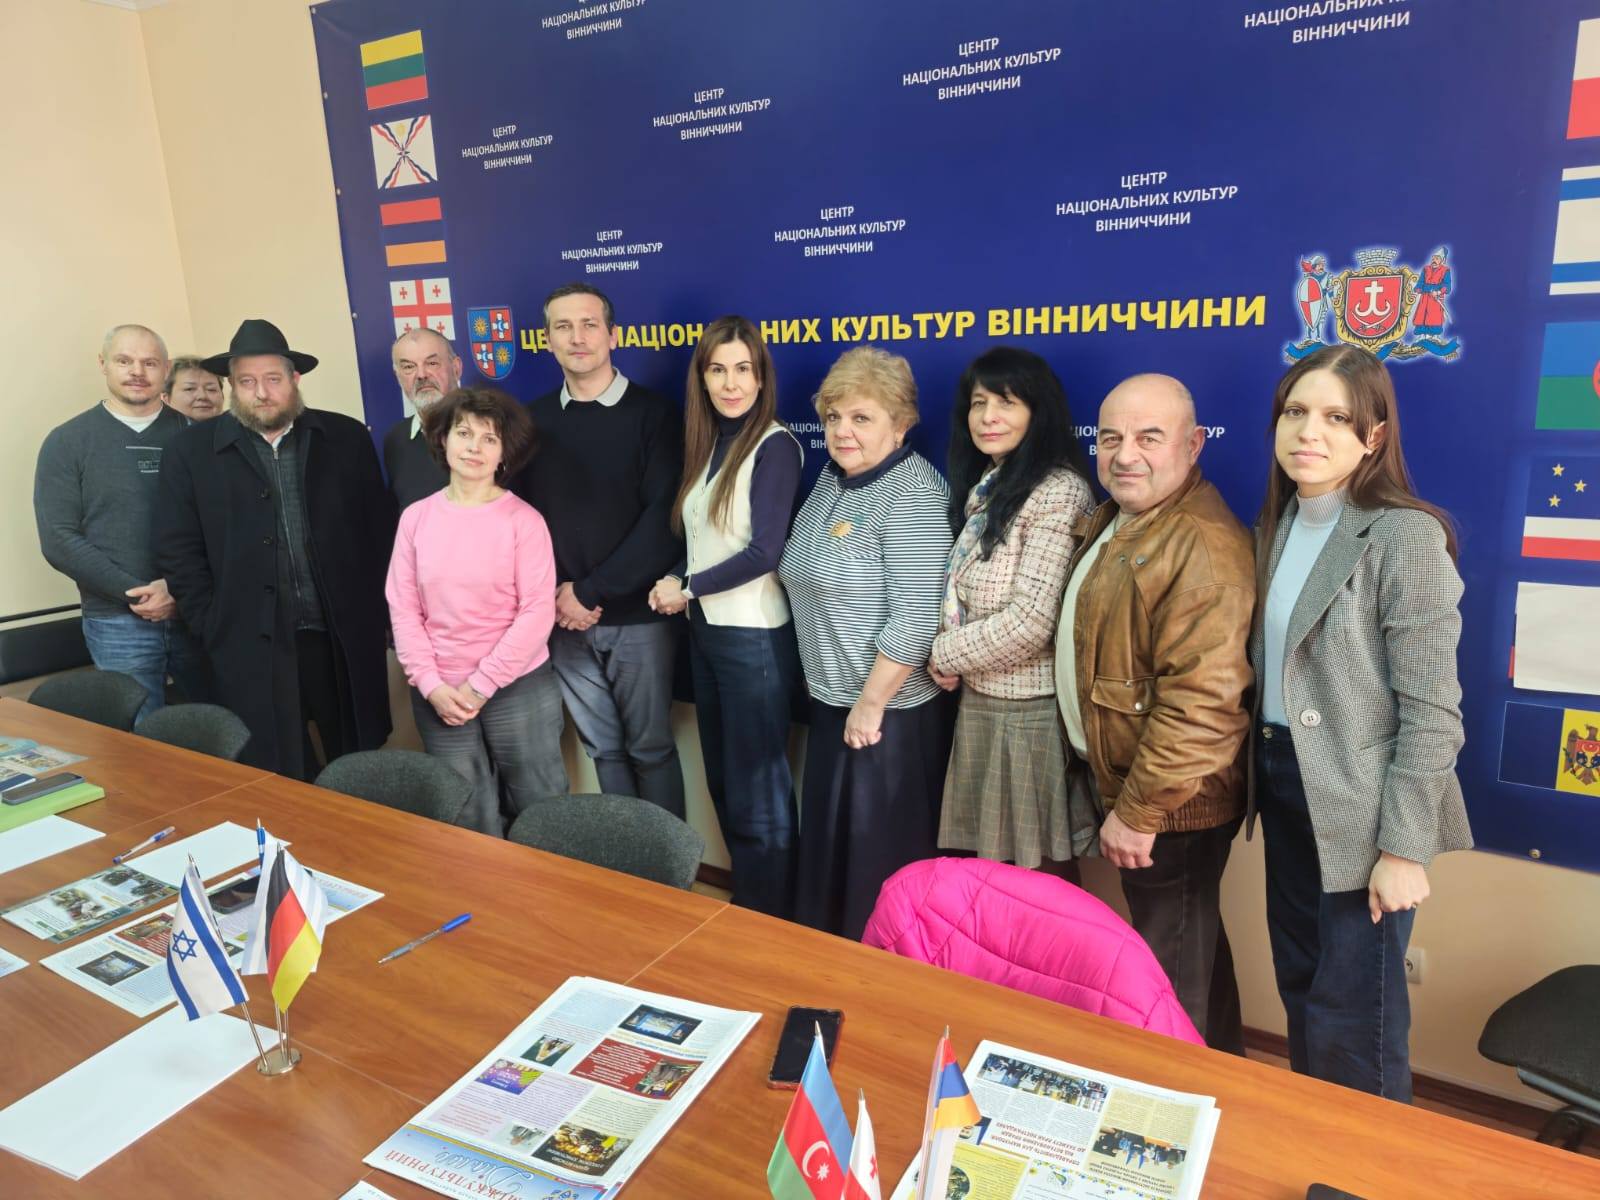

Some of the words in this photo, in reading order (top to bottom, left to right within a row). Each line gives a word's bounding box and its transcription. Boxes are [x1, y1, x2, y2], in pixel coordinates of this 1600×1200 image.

[541, 3, 608, 29] НАЦІОНАЛЬНИХ
[566, 17, 623, 40] ВІННИЧЧИНИ
[1292, 10, 1411, 44] ВІННИЧЧИНИ
[958, 37, 1000, 58] ЦЕНТР
[902, 57, 1002, 86] НАЦІОНАЛЬНИХ
[1003, 47, 1062, 71] КУЛЬТУР
[694, 87, 725, 105] ЦЕНТР
[937, 75, 1022, 100] ВІННИЧЧИНИ
[652, 105, 728, 128] НАЦІОНАЛЬНИХ
[728, 98, 771, 115] КУЛЬТУР
[492, 124, 517, 139] ЦЕНТР
[680, 120, 743, 141] ВІННИЧЧИНИ
[461, 140, 519, 159] НАЦІОНАЛЬНИХ
[520, 134, 553, 149] КУЛЬТУР
[483, 153, 533, 170] ВІННИЧЧИНИ
[1121, 171, 1168, 190] ЦЕНТР
[1056, 193, 1169, 217] НАЦІОНАЛЬНИХ
[1172, 185, 1239, 204] КУЛЬТУР
[820, 205, 855, 222] ЦЕНТР
[1095, 211, 1192, 233] ВІННИЧЧИНИ
[596, 229, 623, 243] ЦЕНТР
[774, 223, 857, 243] НАЦІОНАЛЬНИХ
[859, 219, 906, 235] КУЛЬТУР
[561, 245, 626, 262] НАЦІОНАЛЬНИХ
[626, 242, 663, 255] КУЛЬТУР
[804, 240, 873, 257] ВІННИЧЧИНИ
[585, 260, 640, 274] ВІННИЧЧИНИ
[616, 319, 820, 351] АЦІОННИХ
[832, 313, 976, 342] КУЛЬТУР
[988, 295, 1266, 337] ВІННИЧЧИНИ
[787, 422, 825, 435] АЦІОНА
